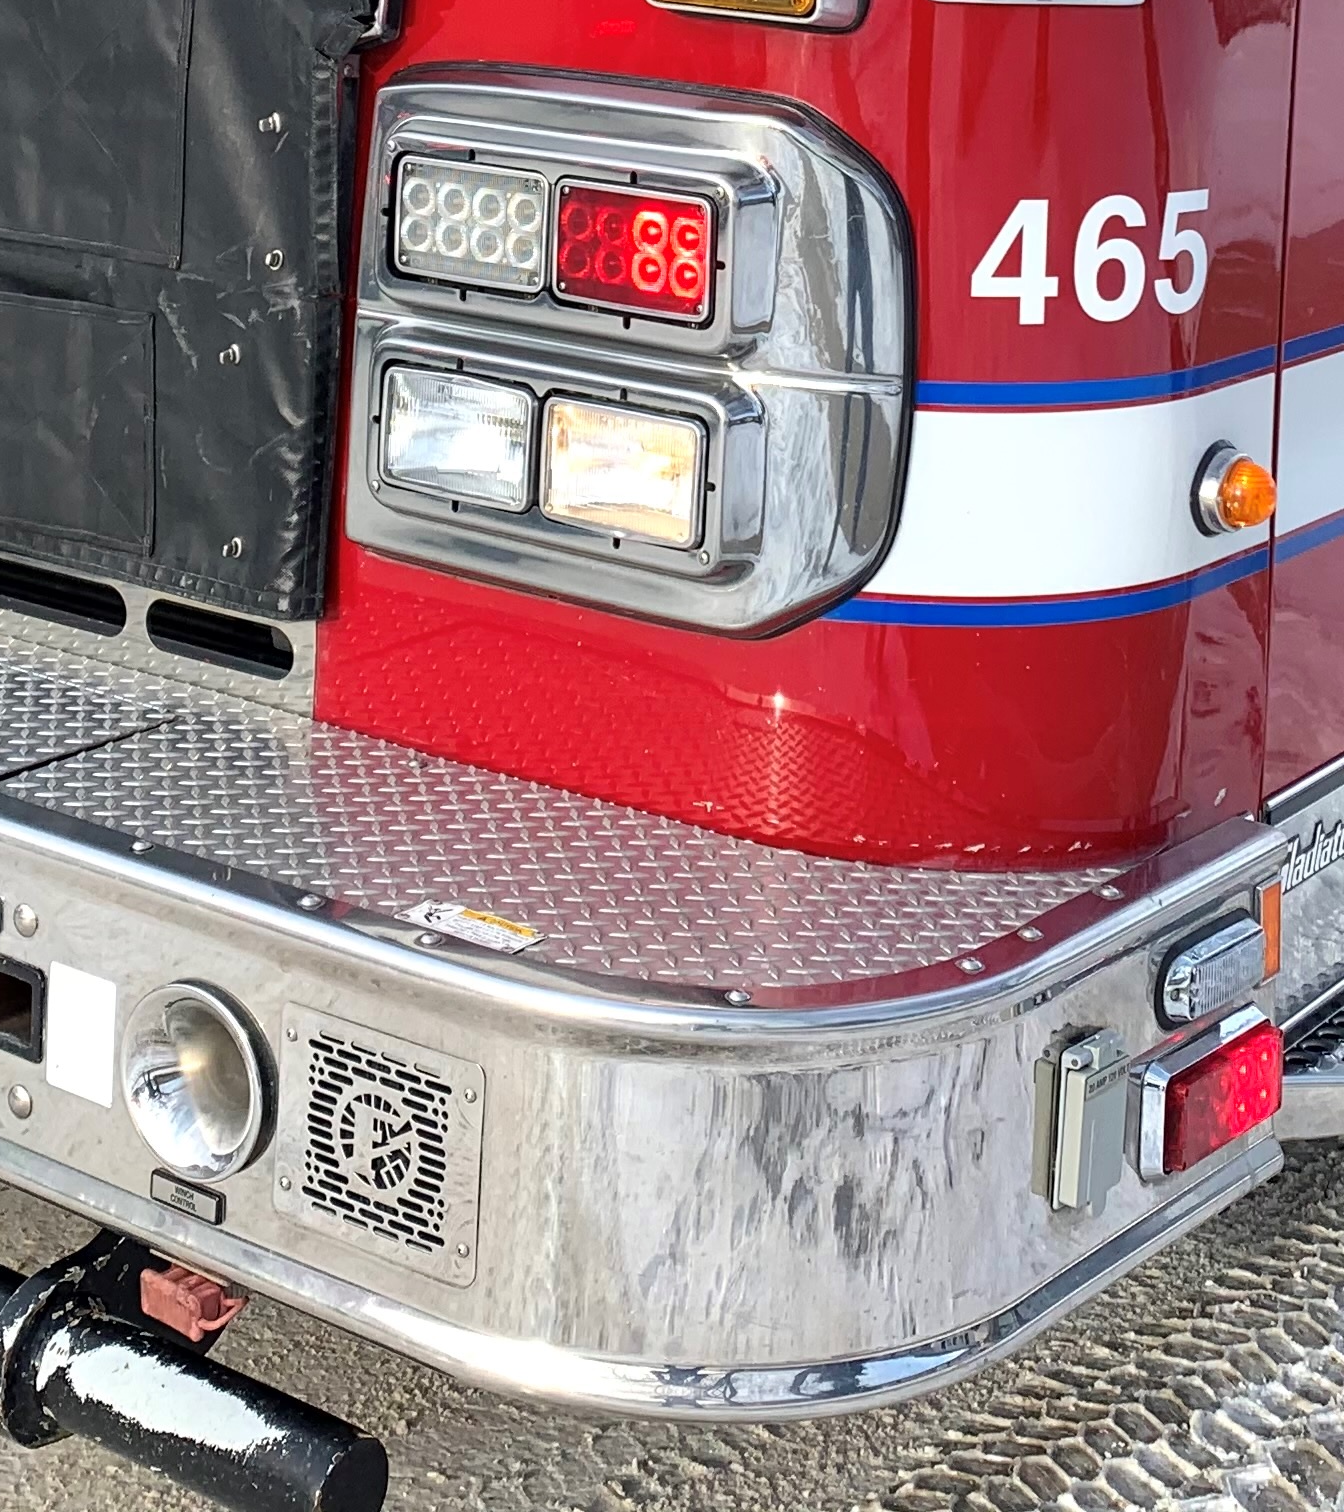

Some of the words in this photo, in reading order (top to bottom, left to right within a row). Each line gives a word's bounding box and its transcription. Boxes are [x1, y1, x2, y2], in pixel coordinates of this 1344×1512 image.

[970, 188, 1210, 326] 465
[174, 1185, 195, 1200] WINCH
[170, 1193, 197, 1213] CONTROL
